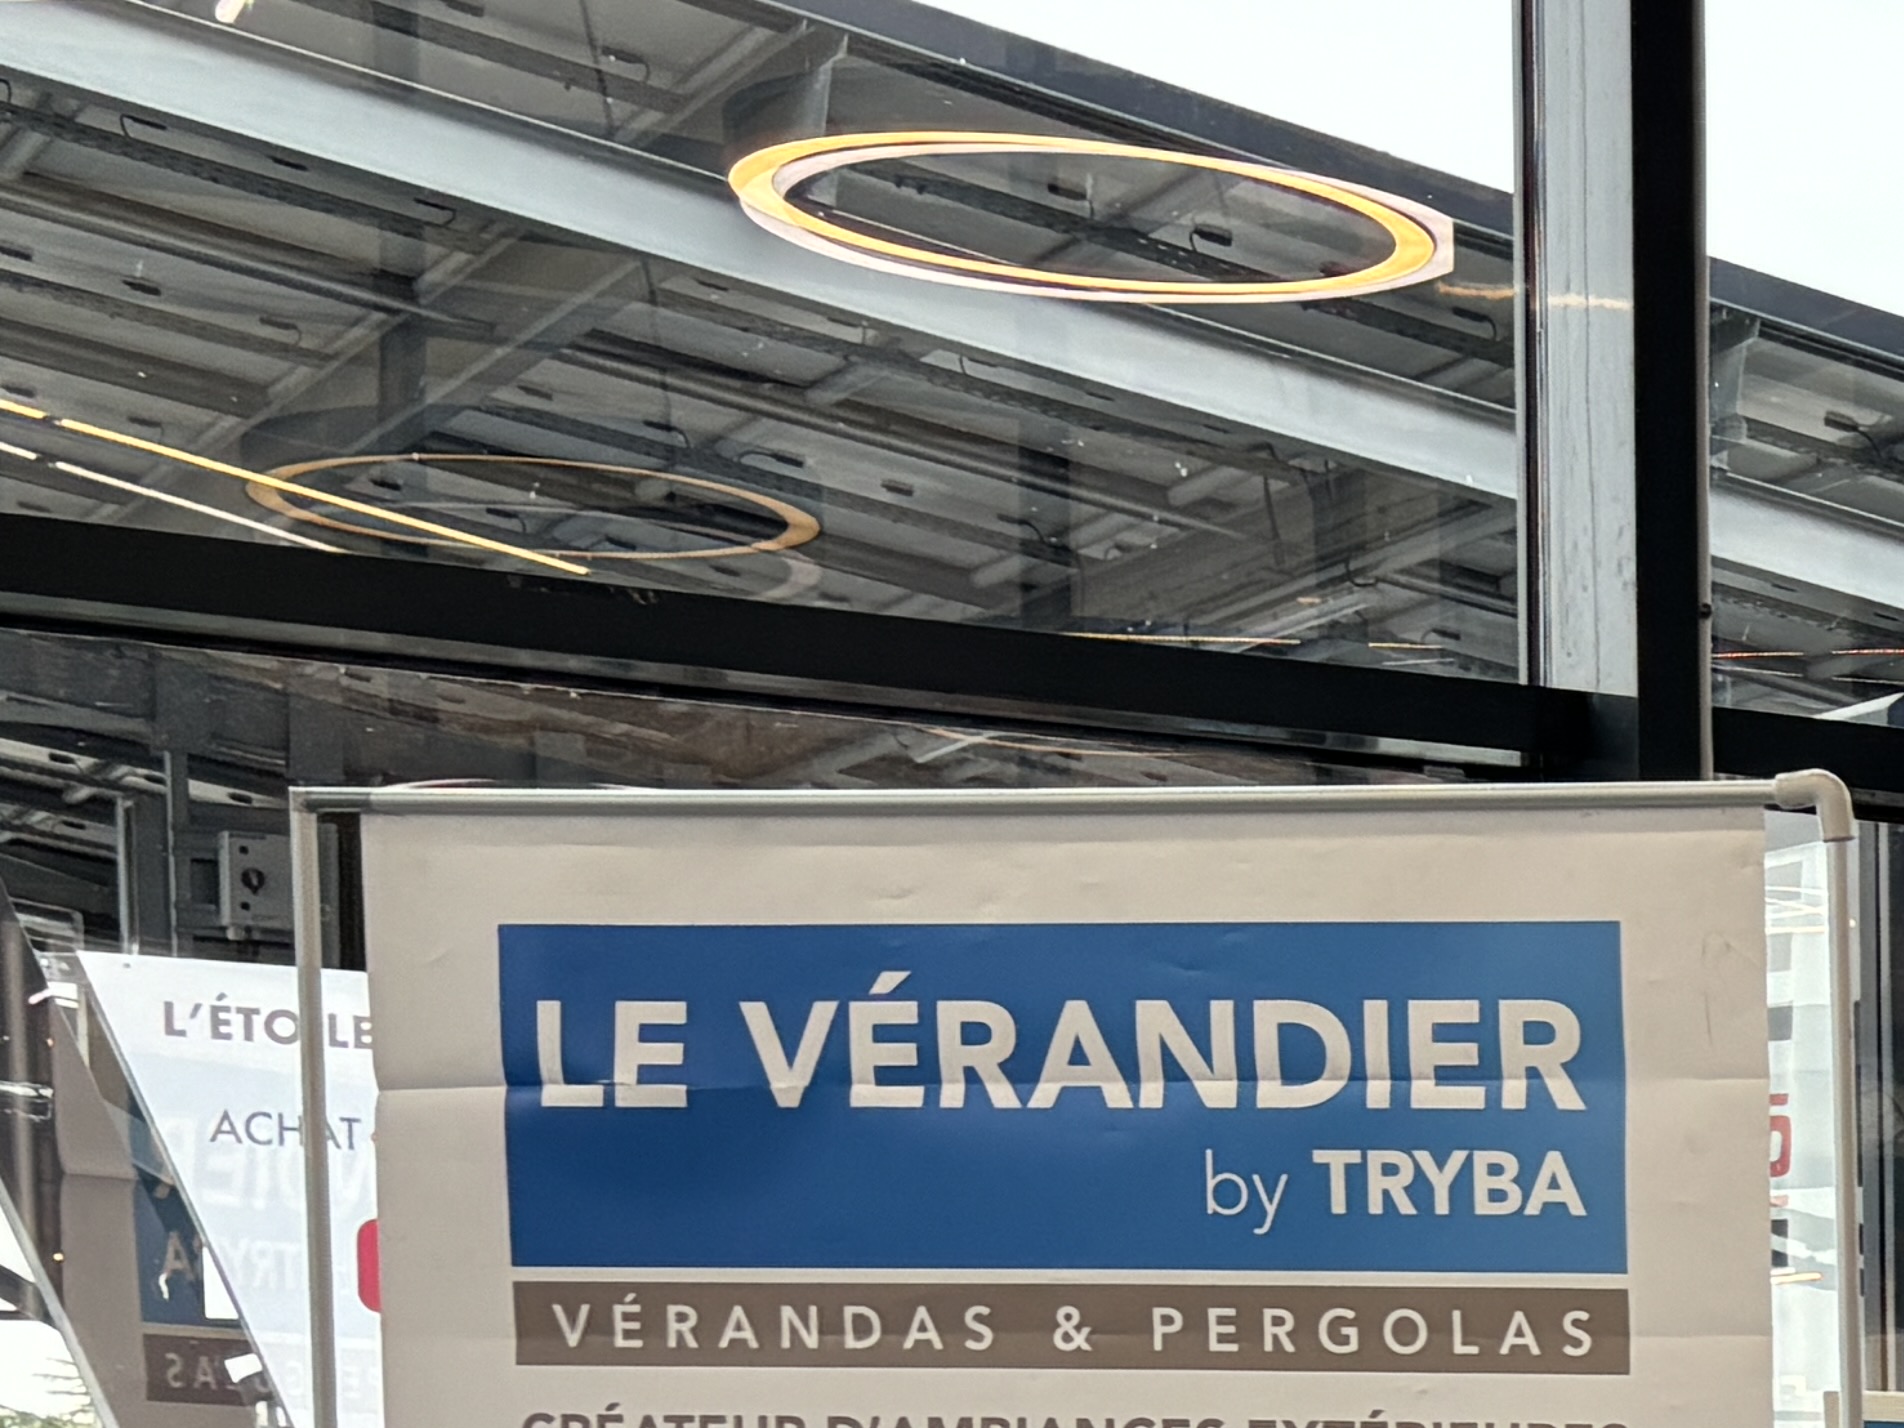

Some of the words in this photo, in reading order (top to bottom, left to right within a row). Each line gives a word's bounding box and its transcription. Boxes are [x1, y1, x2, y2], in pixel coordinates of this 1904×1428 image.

[163, 993, 374, 1050] L'ÉTOLE
[535, 999, 688, 1110] LE
[739, 970, 1586, 1111] VÉRANDIER
[1204, 1150, 1289, 1233] by
[1313, 1150, 1587, 1216] TRYBA
[552, 1291, 998, 1351] VÉRANDAS
[1052, 1303, 1095, 1352] &
[1152, 1306, 1595, 1356] PERGOLAS
